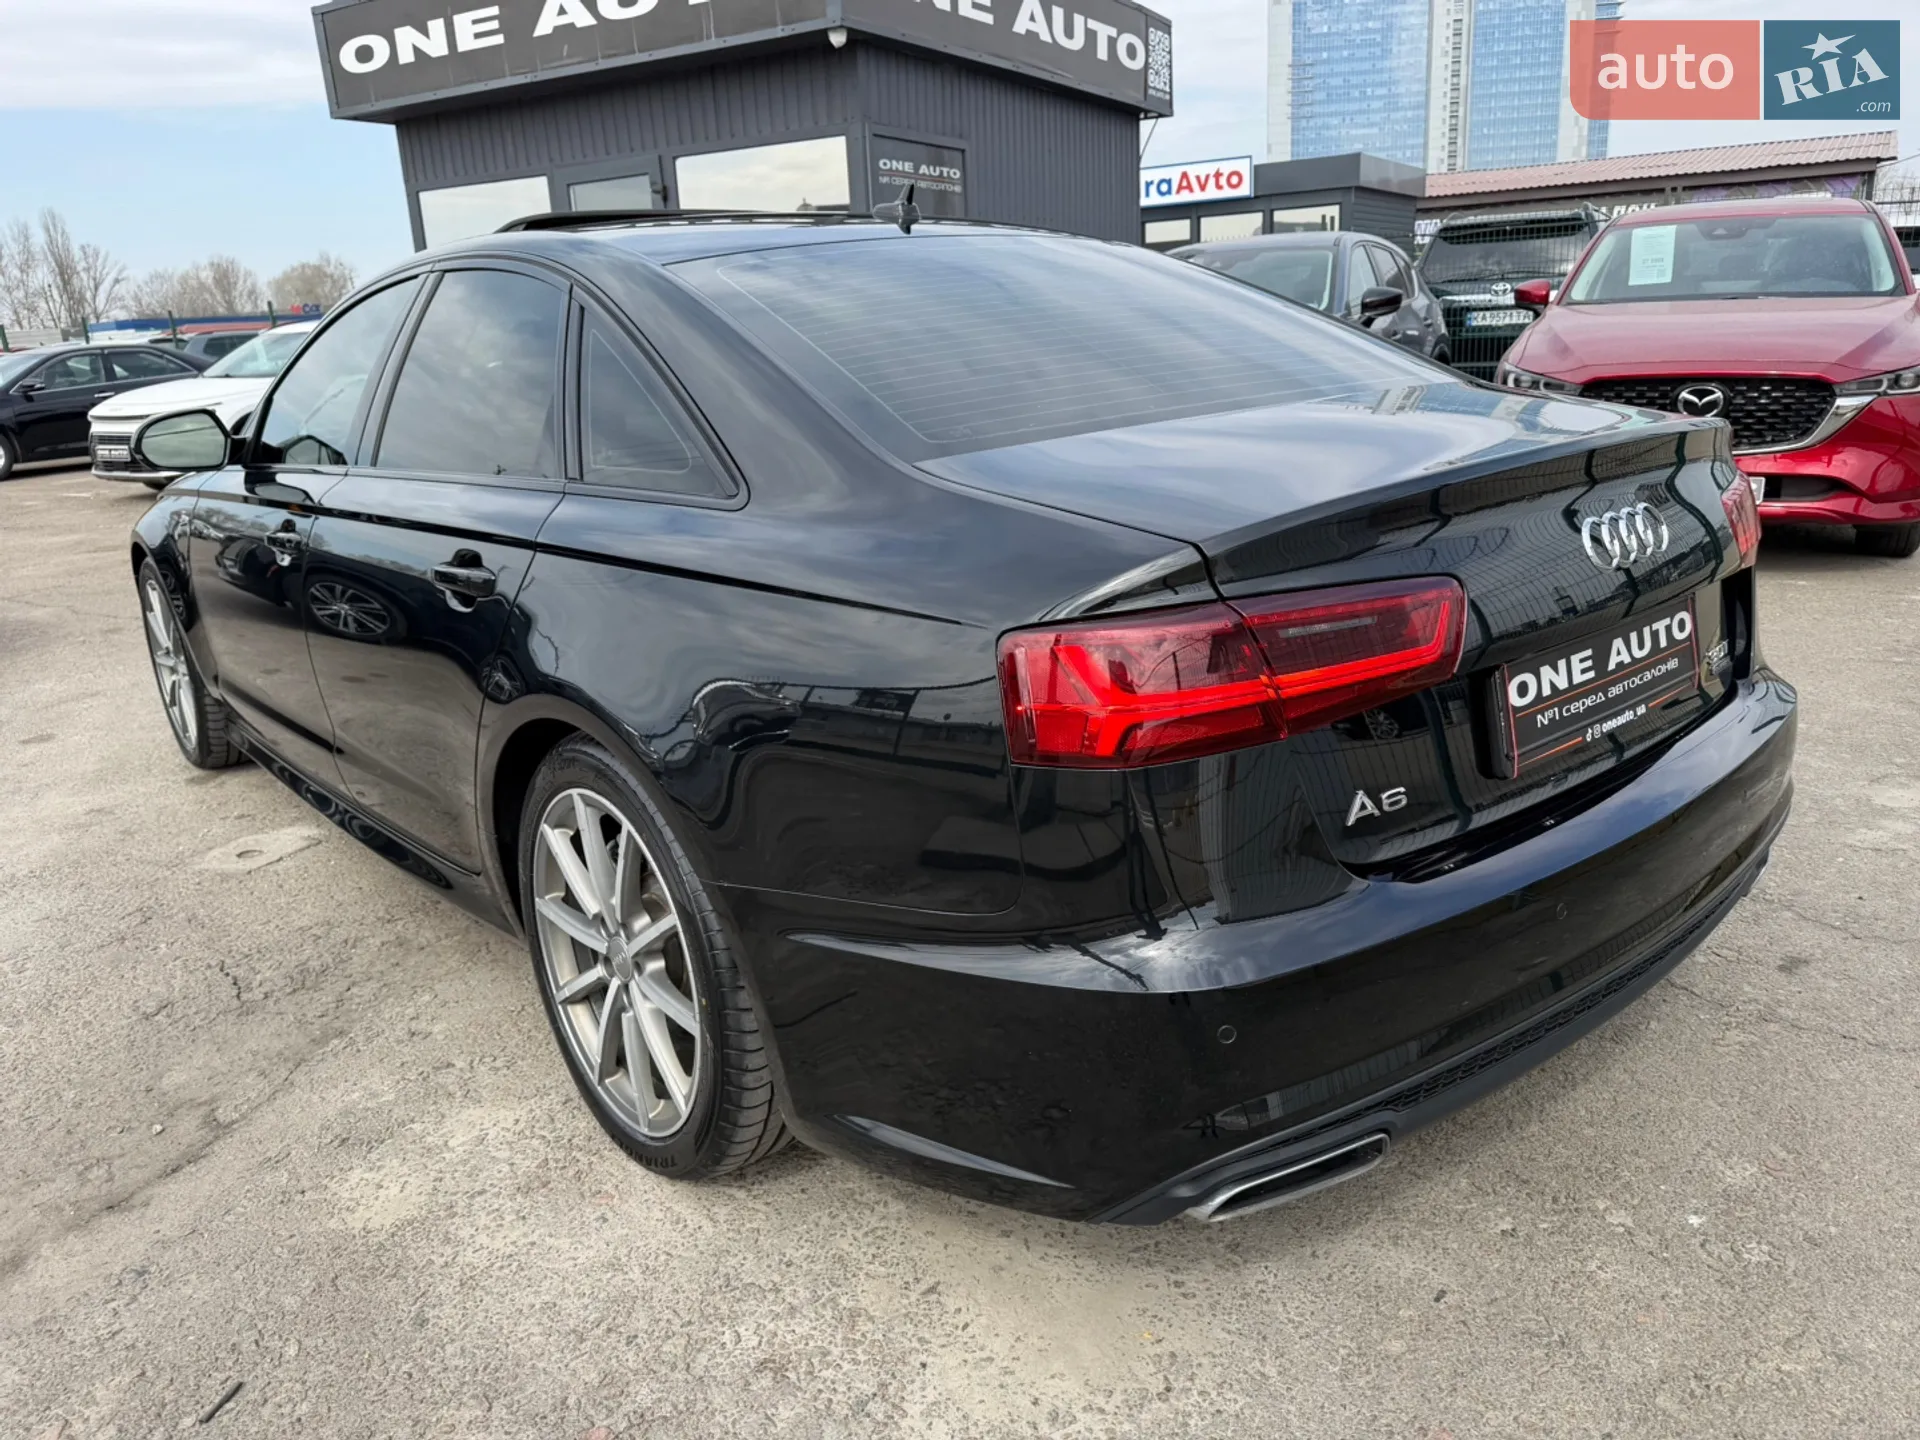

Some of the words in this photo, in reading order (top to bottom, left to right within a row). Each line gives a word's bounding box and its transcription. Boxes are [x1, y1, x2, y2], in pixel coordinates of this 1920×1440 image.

[339, 5, 505, 73] ONE
[1012, 0, 1146, 70] AUTO
[878, 158, 914, 173] ONE
[919, 164, 961, 179] AUTO
[1144, 167, 1243, 198] raAvto
[1508, 648, 1596, 708] ONE
[1607, 610, 1692, 672] AUTO
[1562, 692, 1606, 717] серед
[1608, 657, 1679, 698] автосалонів
[1602, 704, 1647, 733] oneauto_ua
[1345, 786, 1408, 827] A6
